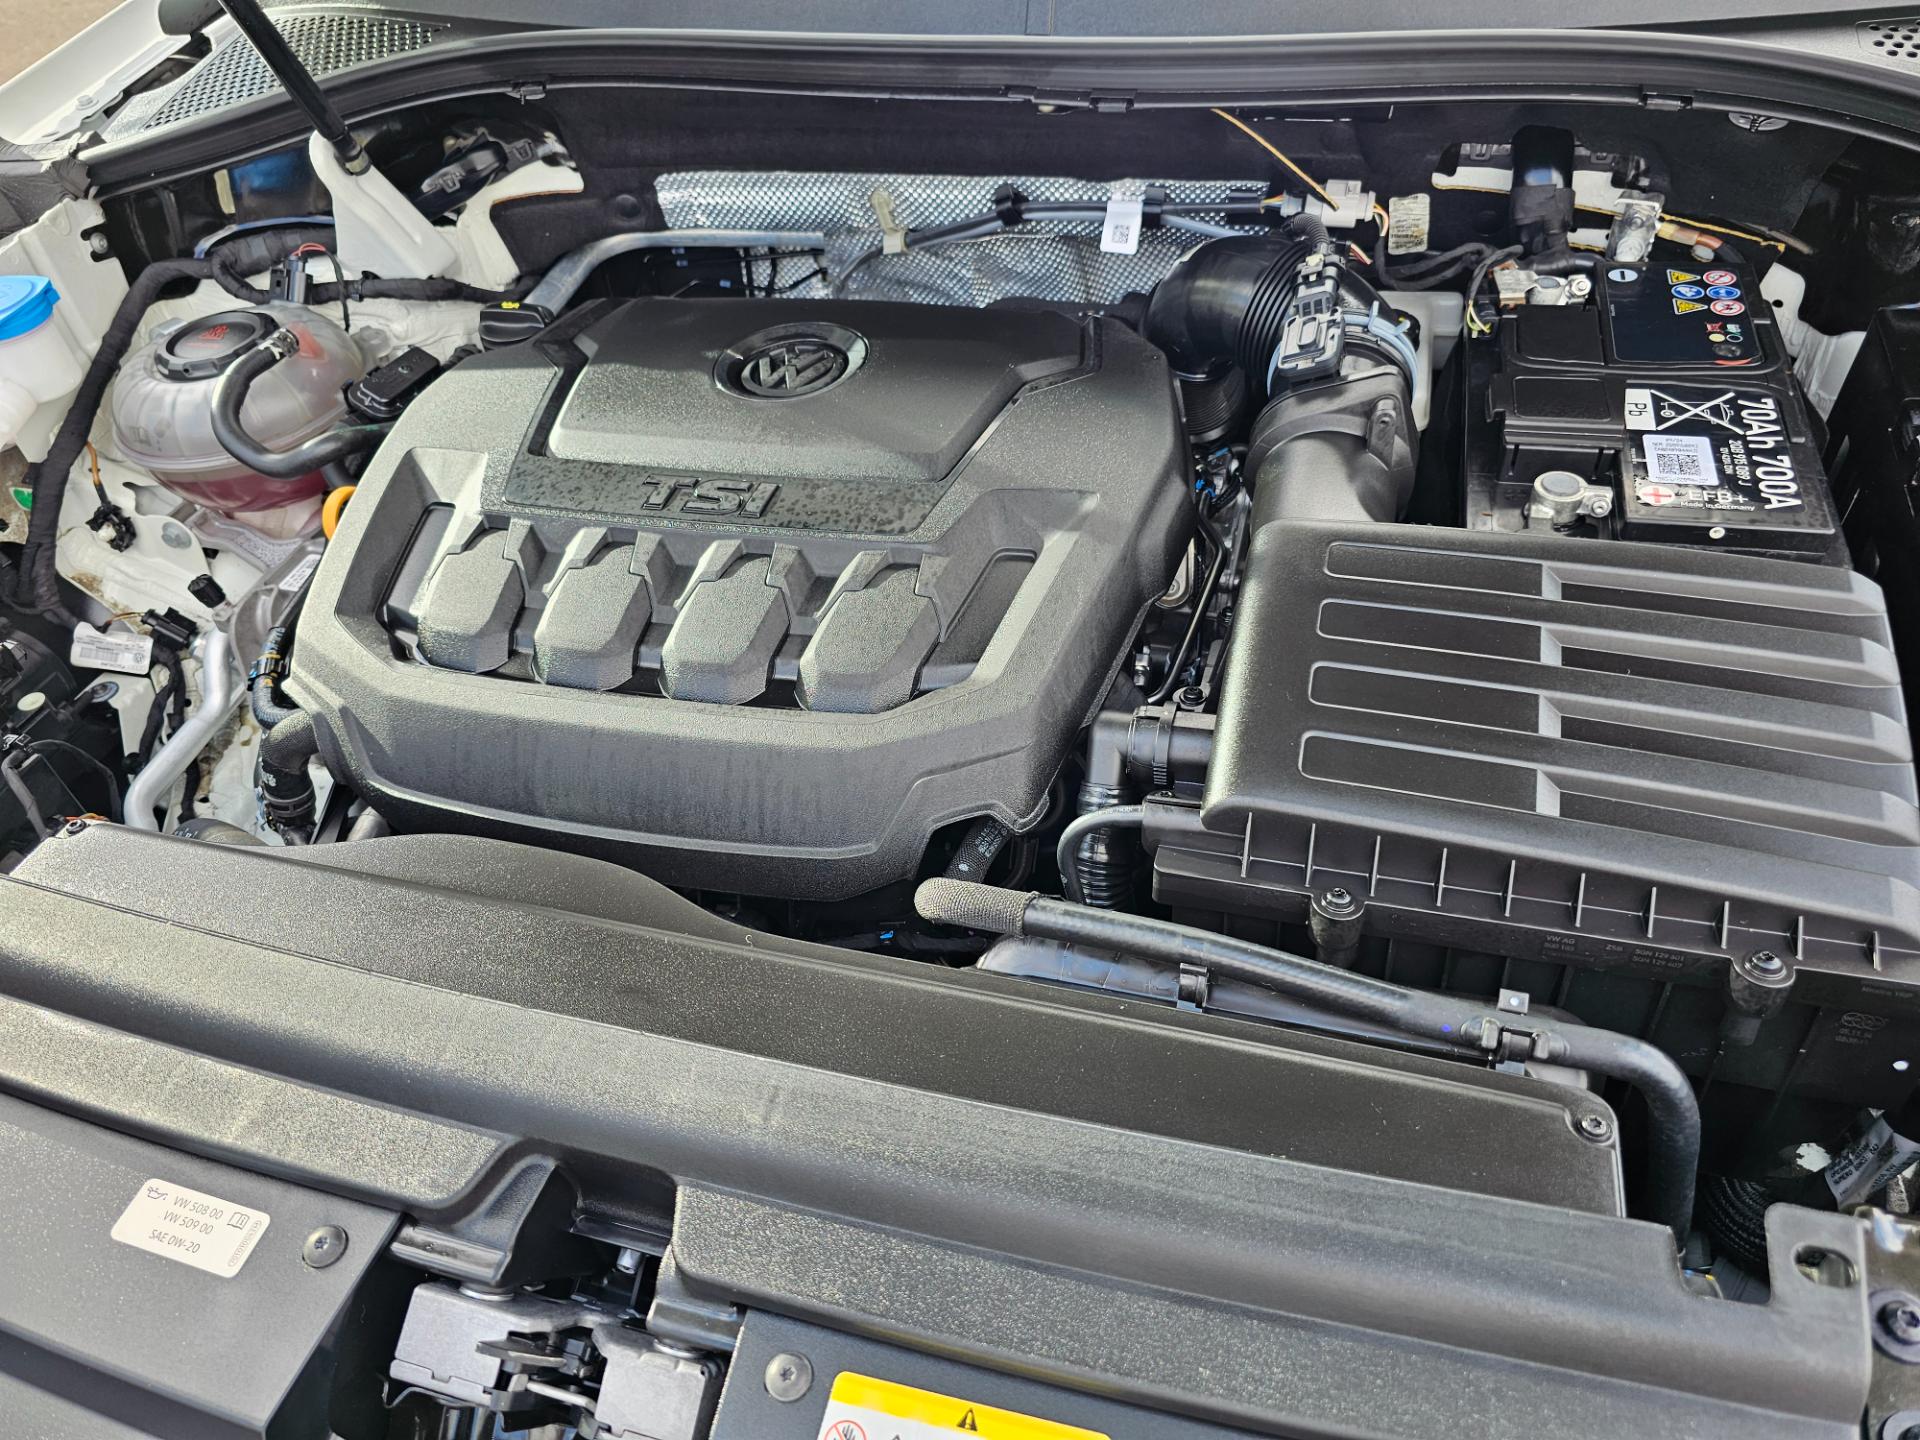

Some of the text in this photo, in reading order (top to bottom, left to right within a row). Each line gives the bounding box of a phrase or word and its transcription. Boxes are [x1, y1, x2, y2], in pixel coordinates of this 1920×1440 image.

[1627, 402, 1648, 417] Pb
[1738, 398, 1802, 510] 70Ah 700A
[642, 473, 783, 519] TSI
[1689, 488, 1749, 504] EFB+
[1714, 503, 1756, 512] Germany
[174, 1196, 223, 1220] VW 508 00
[164, 1210, 213, 1234] VW 509 00
[149, 1229, 200, 1253] SAE 0W-20
